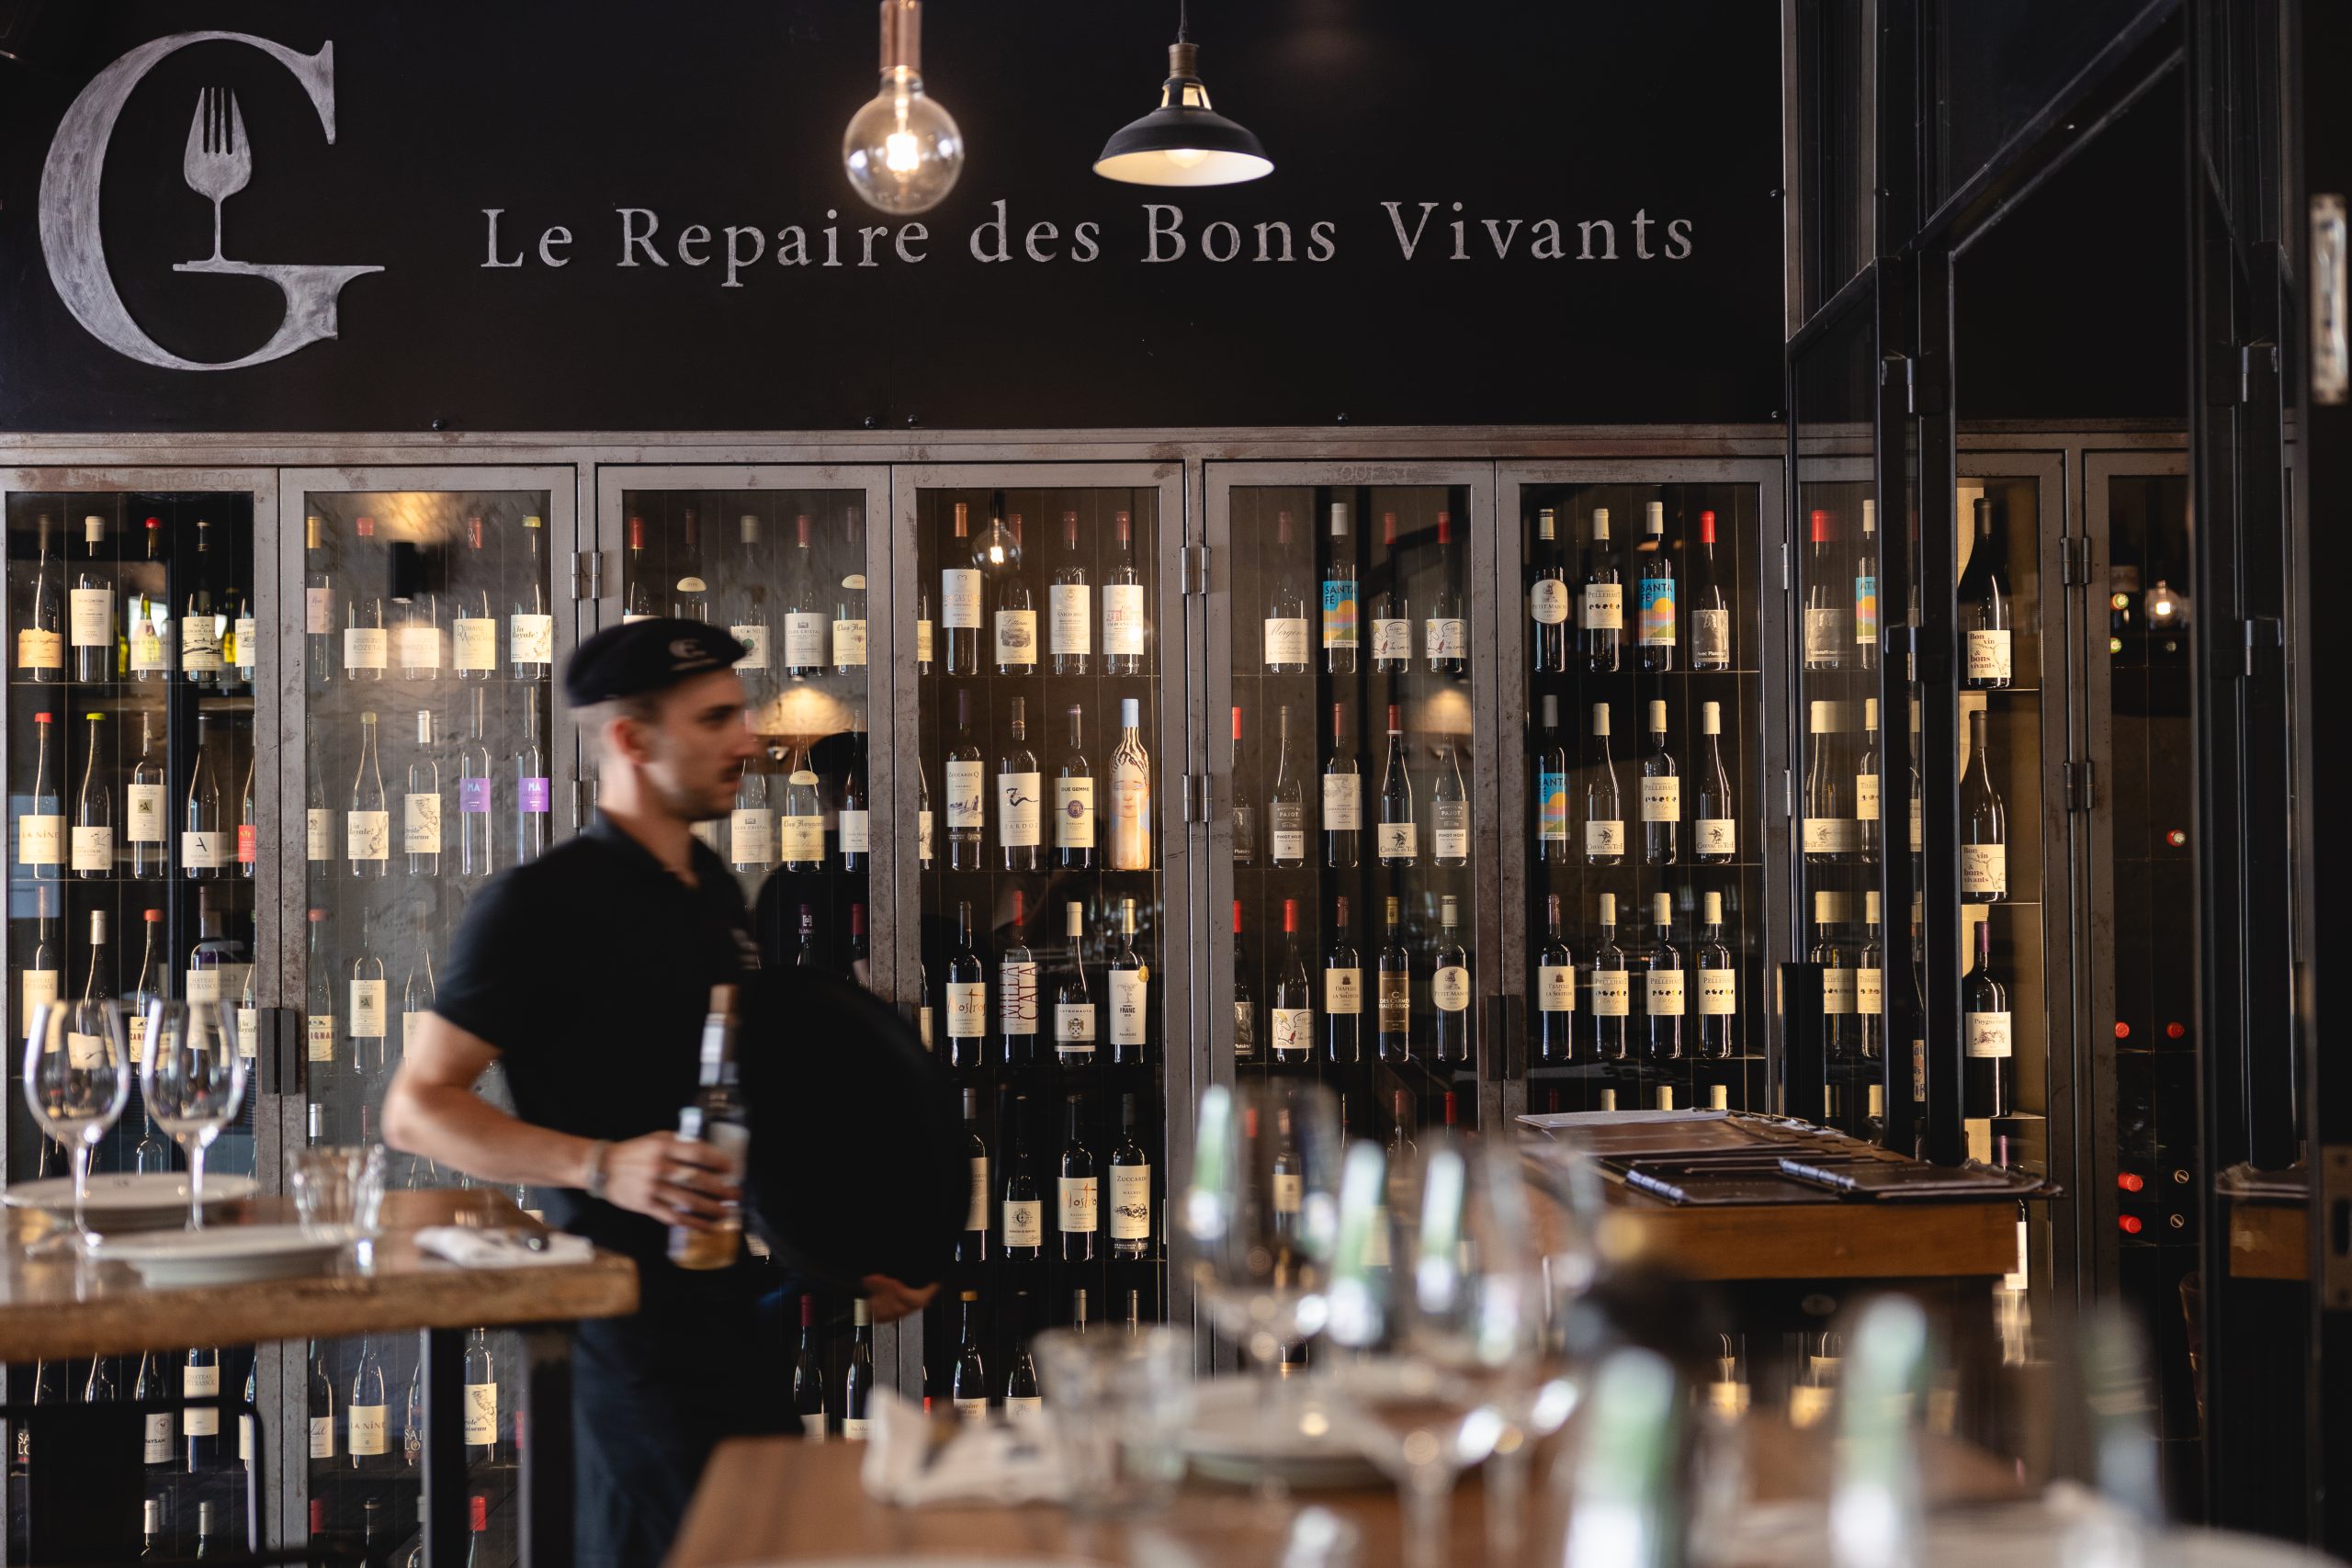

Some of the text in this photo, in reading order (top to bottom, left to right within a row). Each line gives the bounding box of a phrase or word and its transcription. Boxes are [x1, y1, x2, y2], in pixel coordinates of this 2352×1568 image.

[481, 198, 1692, 288] Le Repaire des Bons Vivants
[1325, 584, 1358, 595] SANTA
[1640, 581, 1674, 594] SANTA
[1324, 593, 1336, 605] FÉ
[1970, 654, 1991, 662] bons
[468, 783, 481, 792] MA
[528, 782, 540, 792] MA
[1000, 965, 1021, 1020] MILLA
[1018, 965, 1039, 1021] CALA
